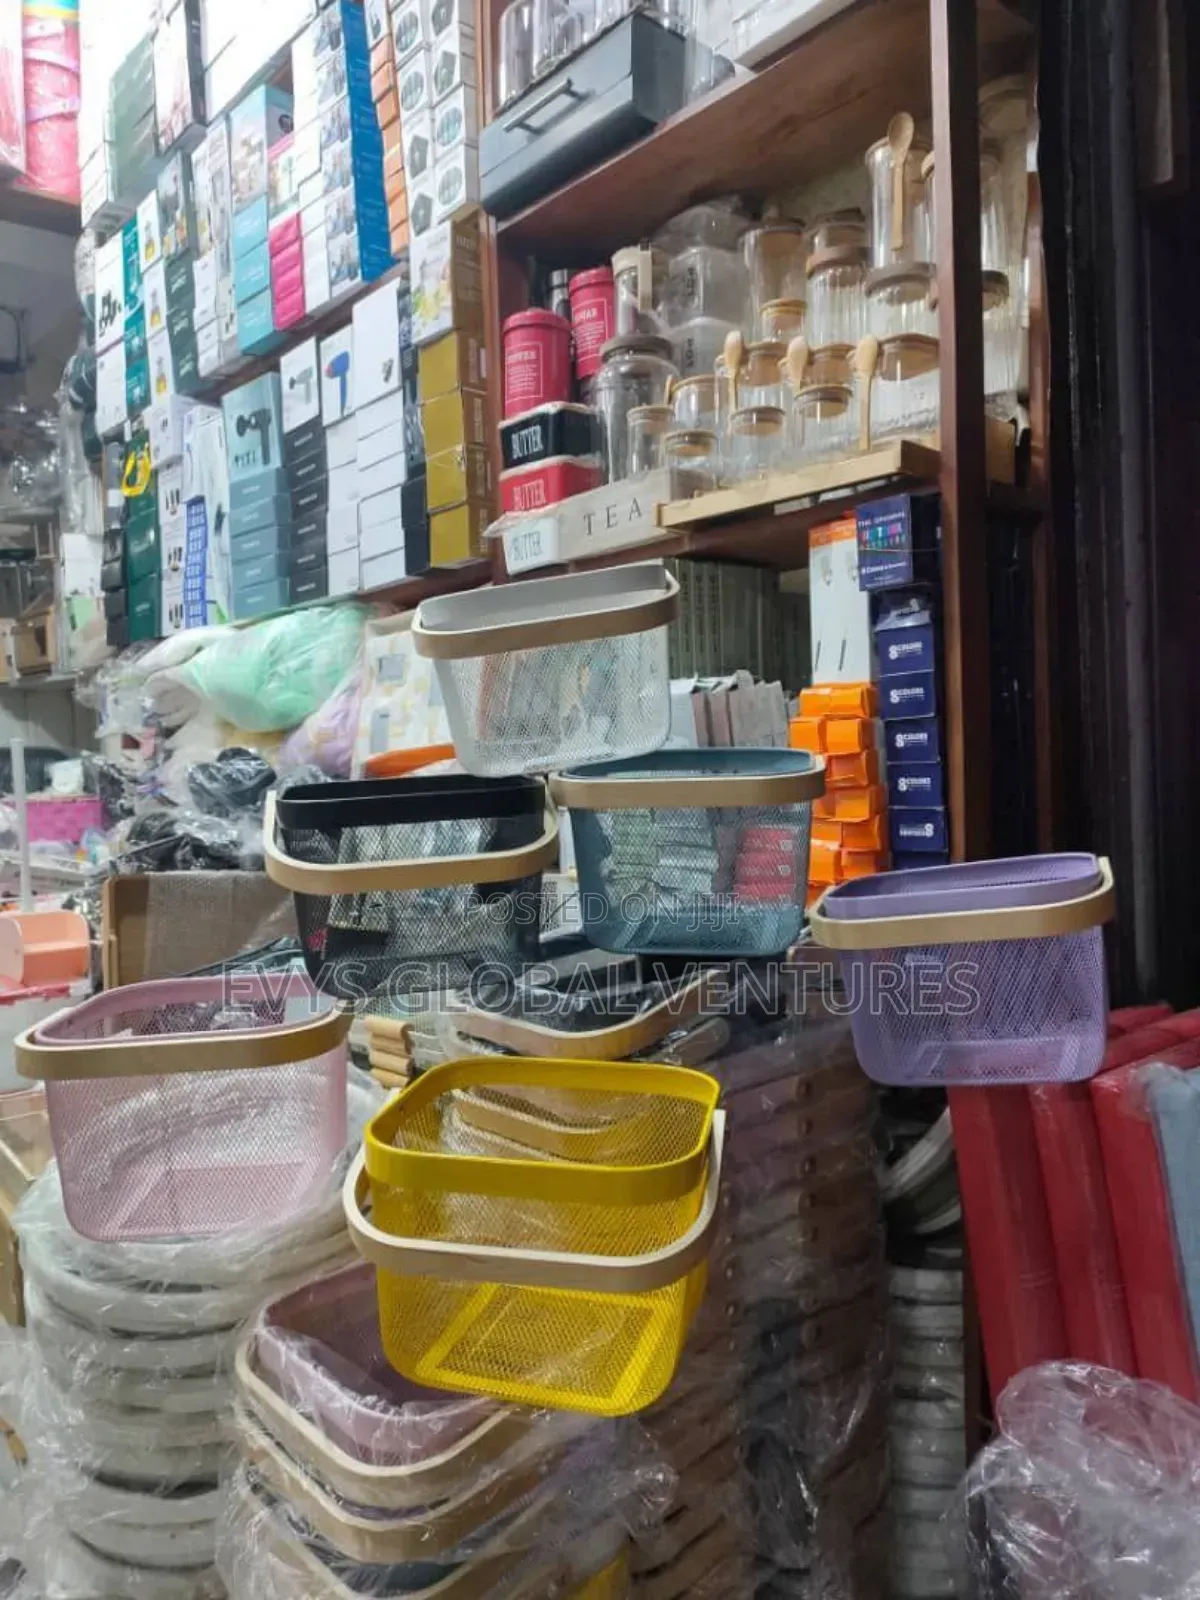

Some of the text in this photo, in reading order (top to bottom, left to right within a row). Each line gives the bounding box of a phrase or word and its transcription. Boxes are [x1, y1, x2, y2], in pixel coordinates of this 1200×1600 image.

[511, 424, 544, 460] BUTTER
[511, 479, 546, 512] BUTTER
[583, 497, 643, 537] TEA
[511, 530, 543, 562] BUTTER
